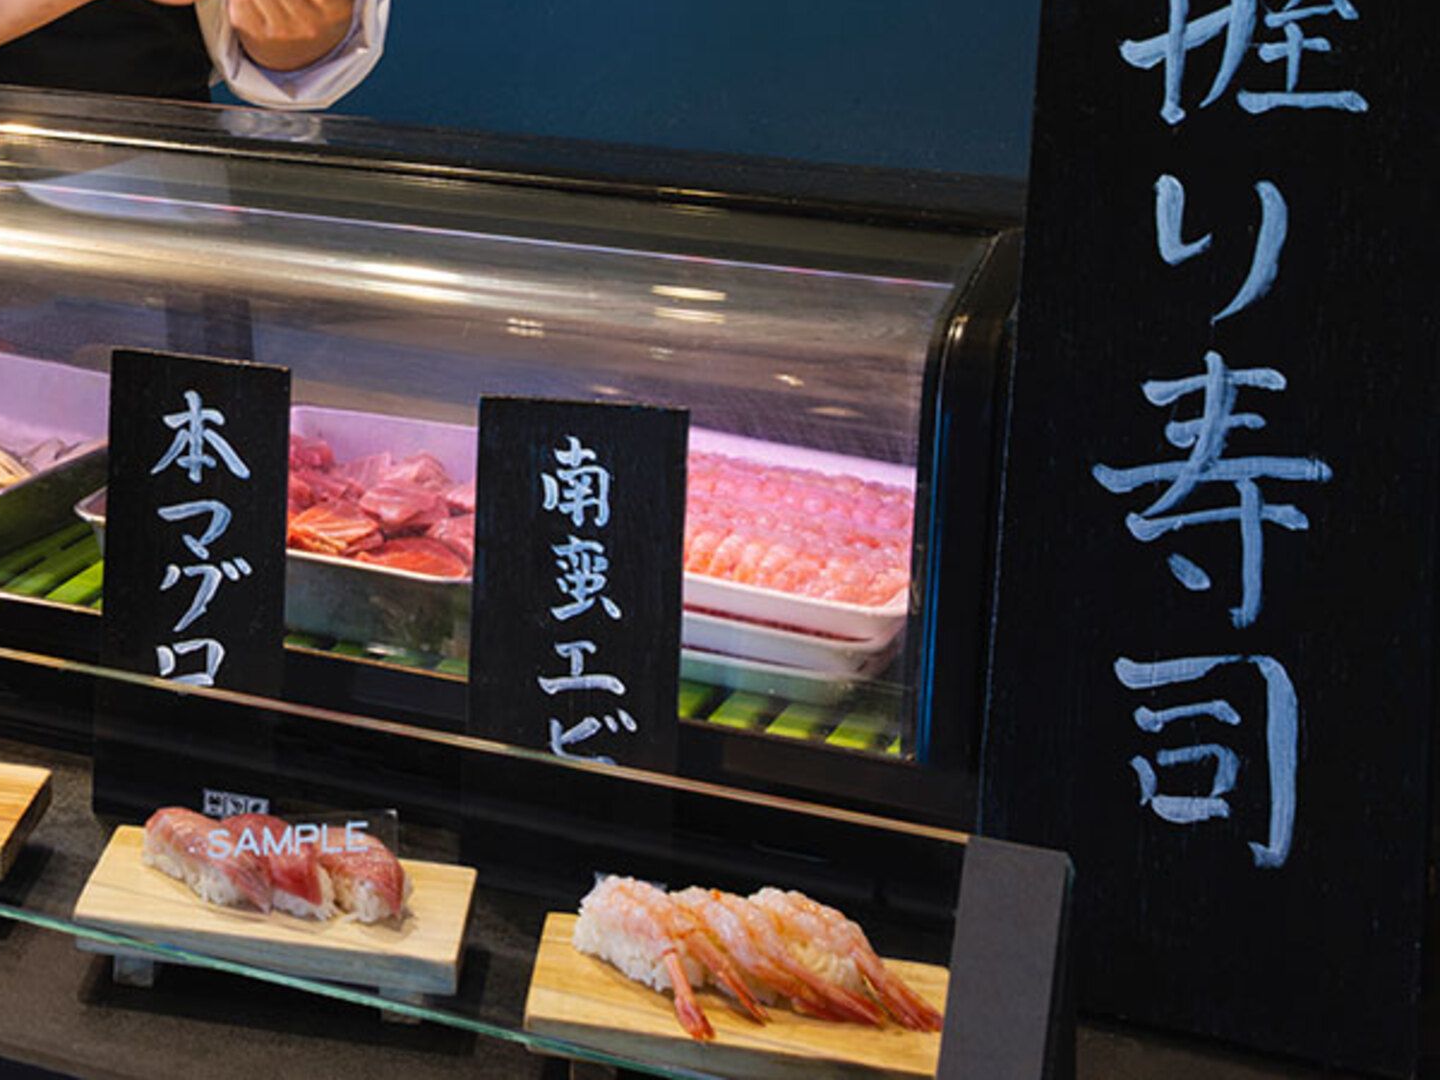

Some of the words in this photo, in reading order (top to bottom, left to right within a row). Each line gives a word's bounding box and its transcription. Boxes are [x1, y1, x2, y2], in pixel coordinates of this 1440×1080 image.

[150, 390, 254, 690] 本マグロ
[537, 435, 638, 766] 南蛮エビ
[207, 820, 369, 860] SAMPLE
